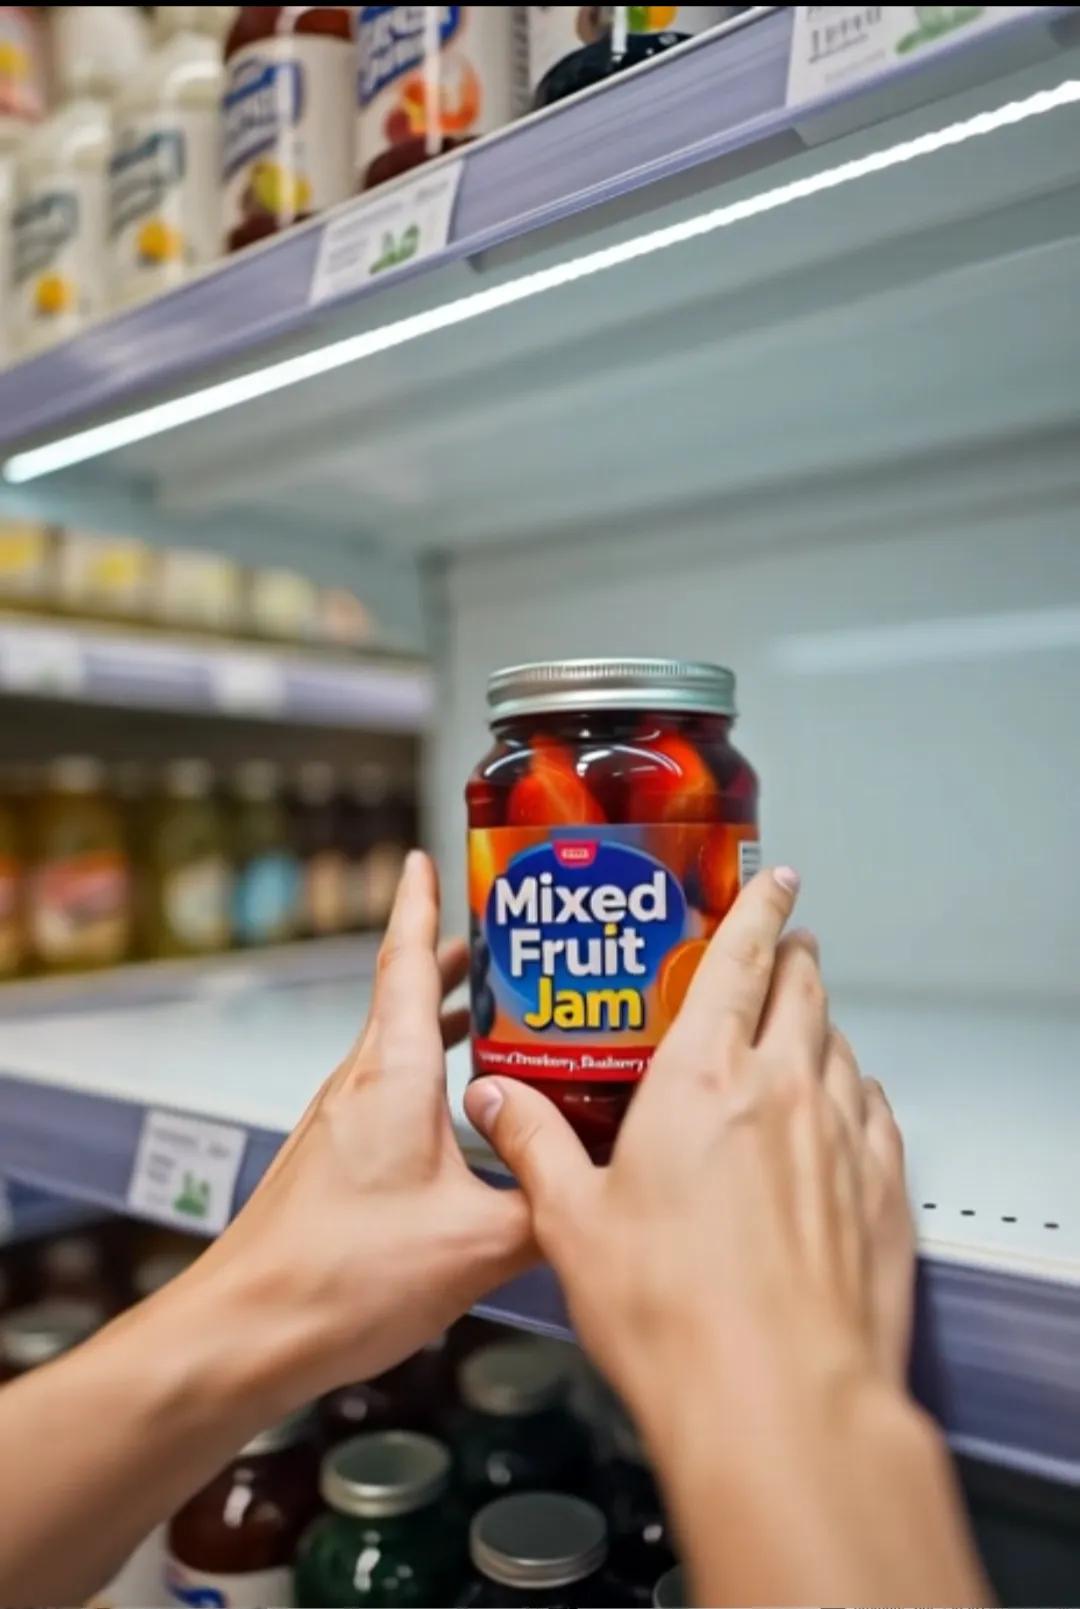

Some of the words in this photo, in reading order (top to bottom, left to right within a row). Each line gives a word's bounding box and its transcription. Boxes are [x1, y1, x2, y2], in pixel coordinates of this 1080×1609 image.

[495, 872, 667, 925] Mixed
[510, 924, 646, 977] Fruit
[523, 976, 643, 1029] Jam
